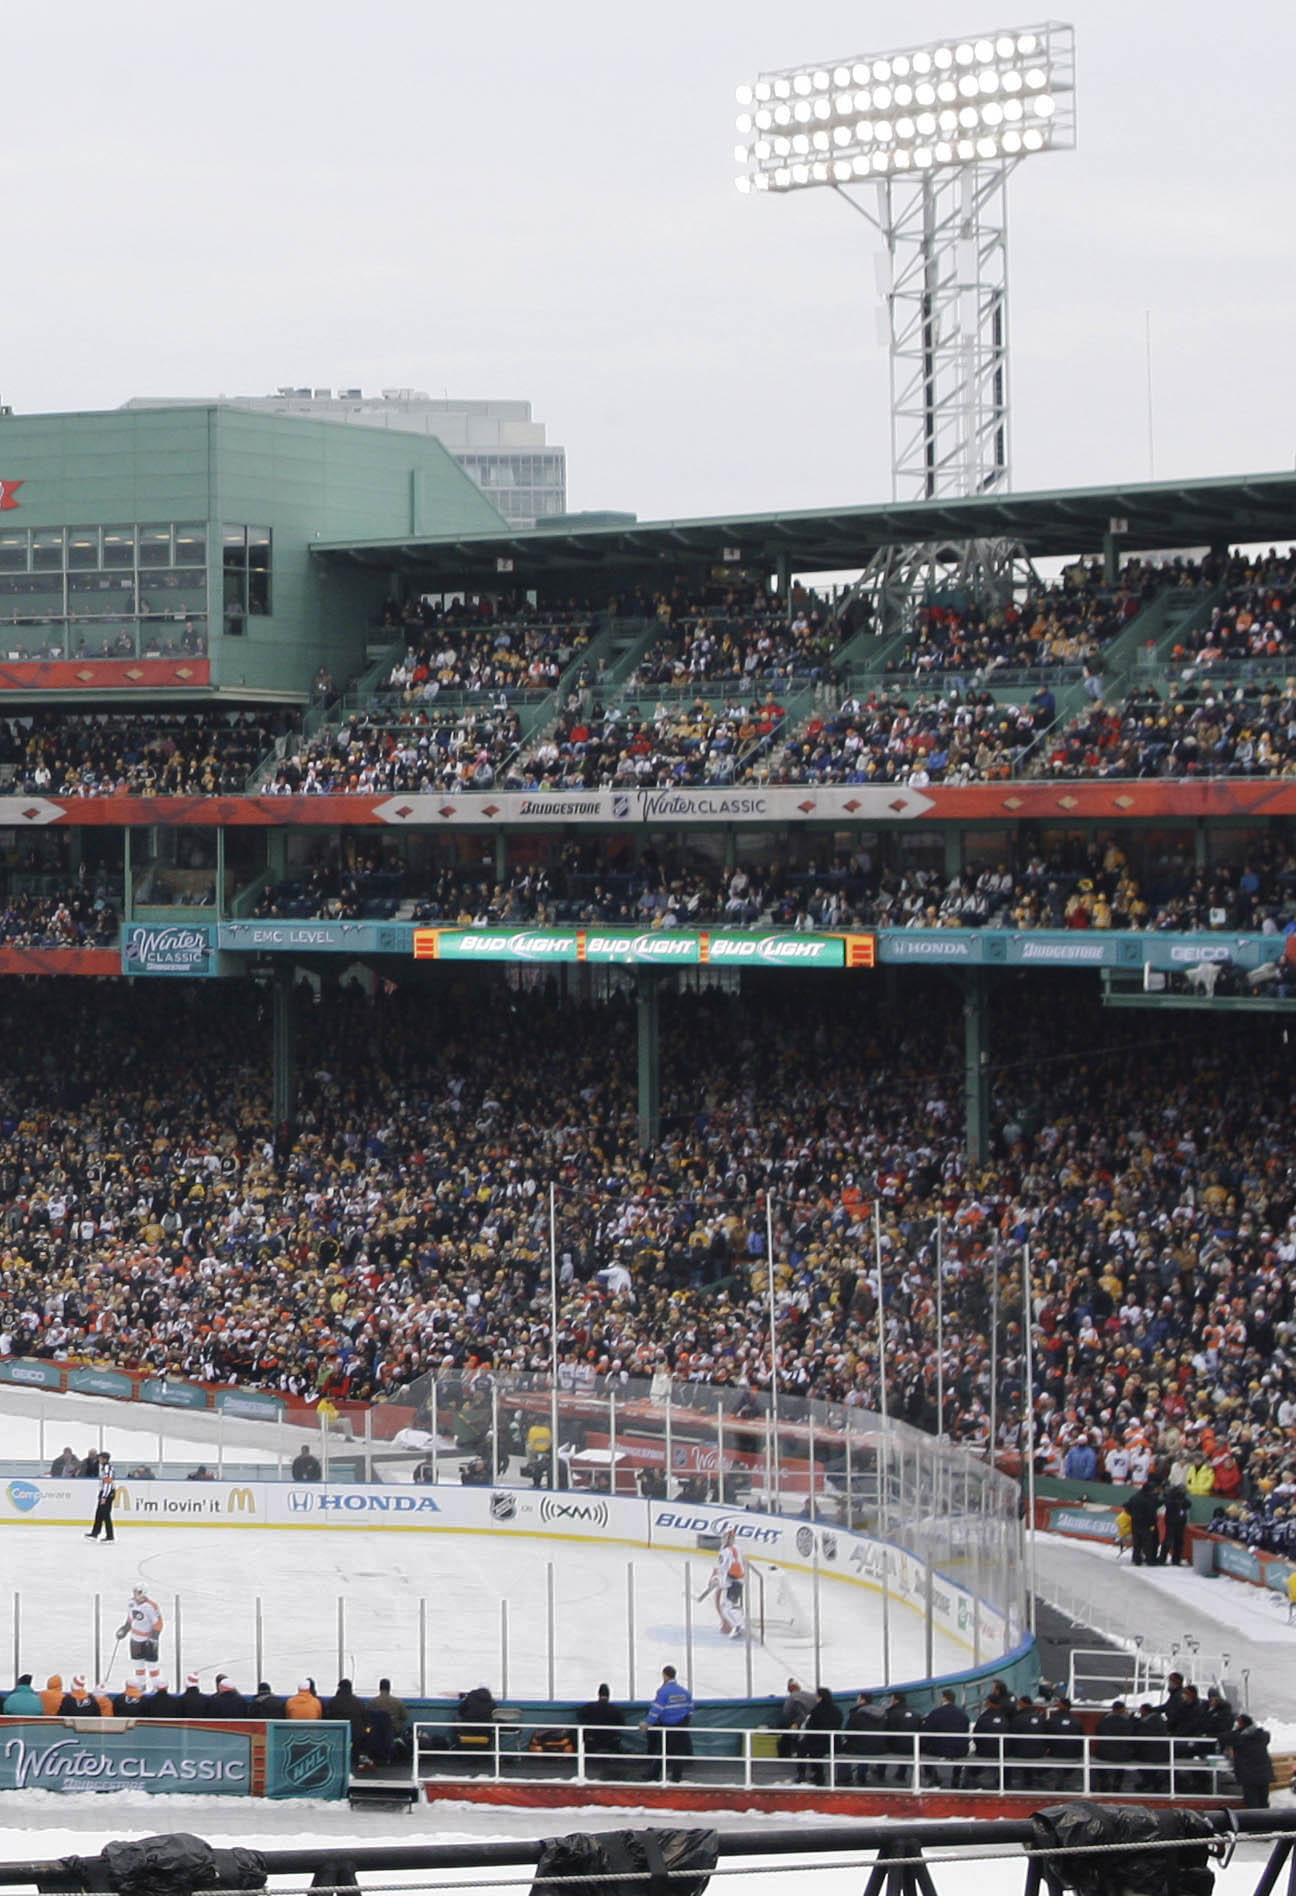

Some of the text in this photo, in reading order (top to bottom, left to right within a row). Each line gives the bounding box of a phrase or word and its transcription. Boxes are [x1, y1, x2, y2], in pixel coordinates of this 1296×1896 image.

[520, 790, 766, 822] BRIDGESTONE Winter CLASSIC
[253, 930, 334, 943] EMC LEVEL
[459, 936, 575, 952] BUD LIGHT
[133, 927, 206, 963] Winter
[589, 938, 696, 954] BUD LIGHT
[710, 939, 826, 957] BUD LIGHT
[908, 943, 968, 954] HONDA
[1023, 943, 1104, 959] BRIDGESTONE
[147, 951, 202, 962] CLASSIC
[1171, 946, 1228, 961] GEICO
[11, 1368, 46, 1381] GEICO
[11, 1487, 72, 1500] Compuware
[135, 1499, 221, 1513] i'm lovin' it
[318, 1494, 441, 1512] HONDA
[655, 1512, 708, 1532] BUD
[6, 1738, 246, 1789] Winter CLASSIC
[292, 1750, 326, 1779] NHL
